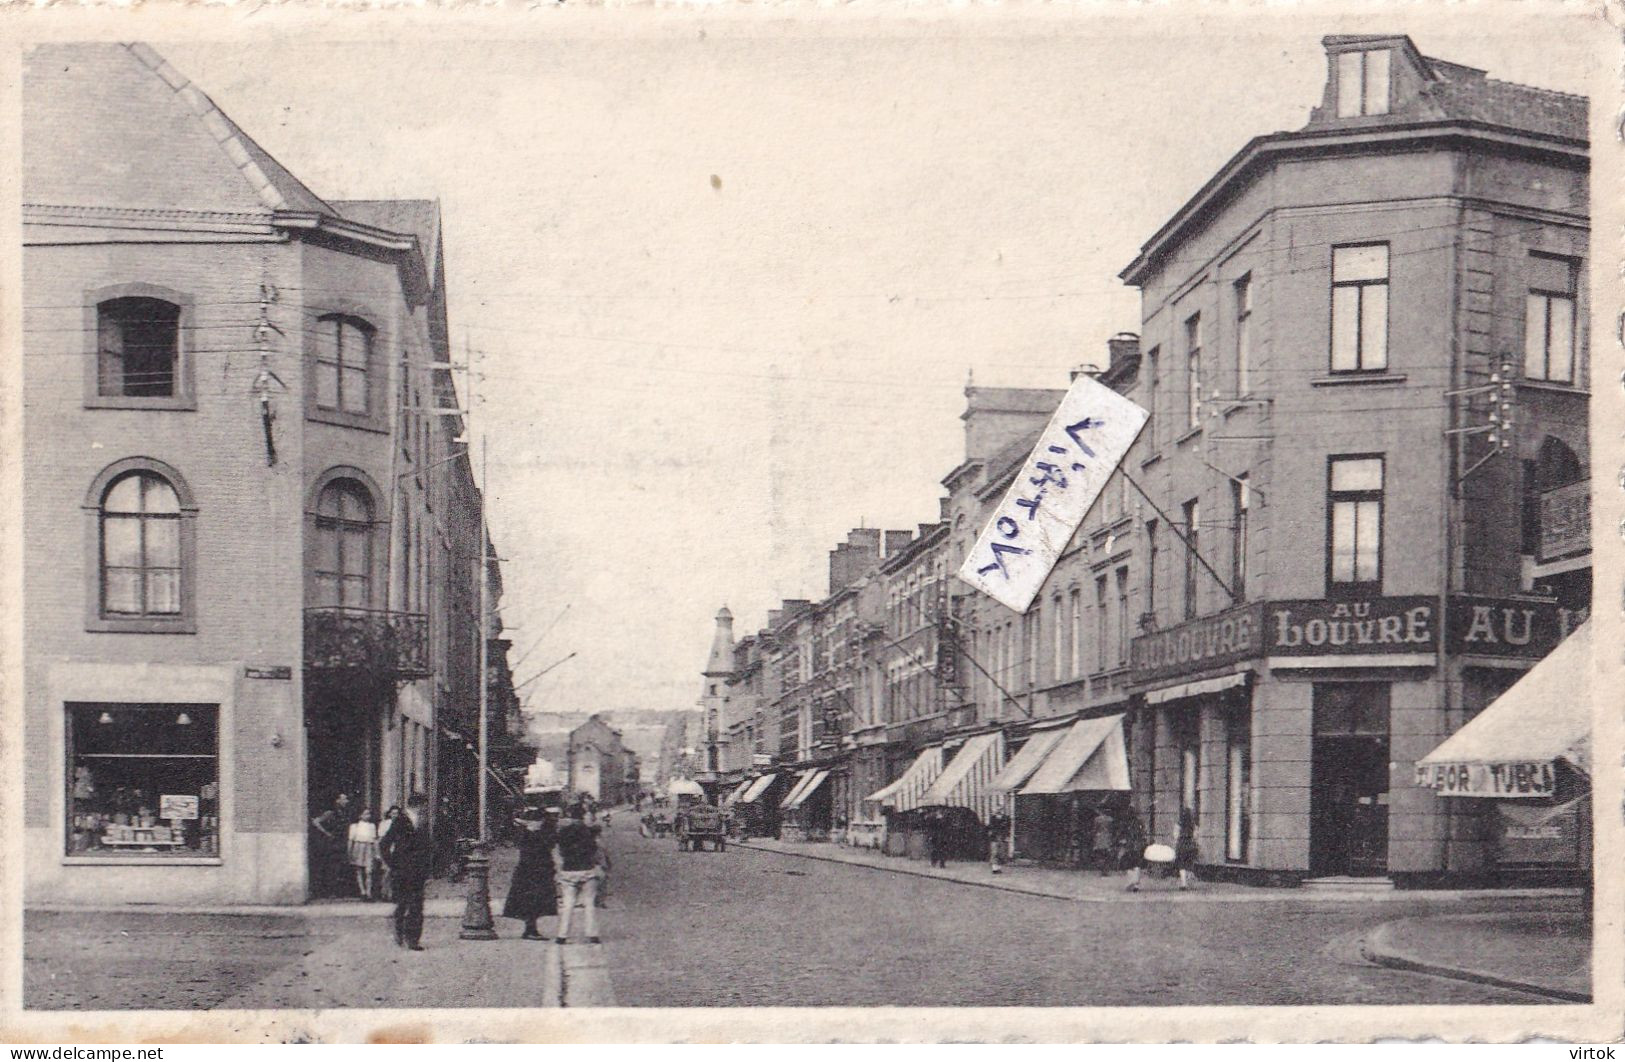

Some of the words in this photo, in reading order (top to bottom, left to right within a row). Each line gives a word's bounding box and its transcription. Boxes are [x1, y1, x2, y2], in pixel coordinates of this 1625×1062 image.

[1273, 606, 1431, 646] LOUVRE
[1332, 602, 1370, 617] AU
[1464, 606, 1535, 645] AU
[1164, 614, 1252, 666] LOUVRE
